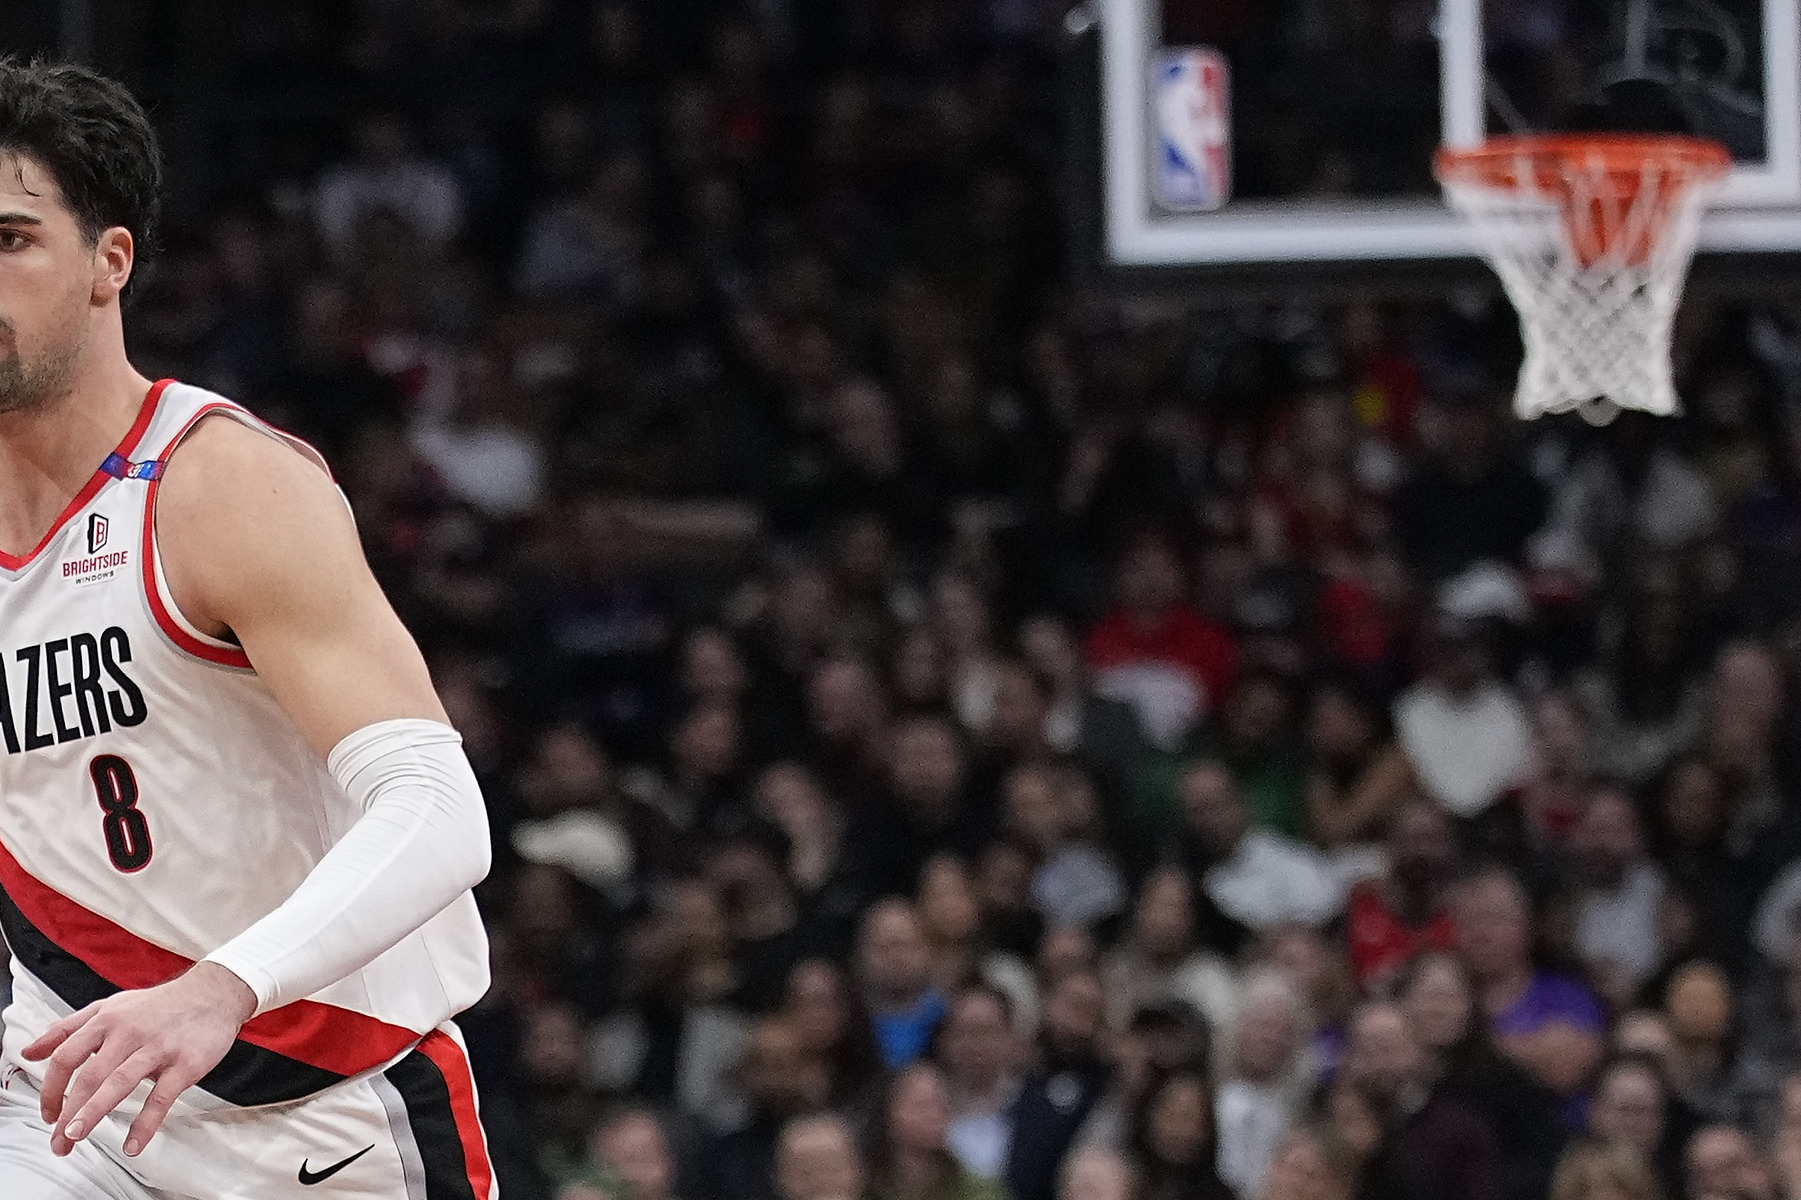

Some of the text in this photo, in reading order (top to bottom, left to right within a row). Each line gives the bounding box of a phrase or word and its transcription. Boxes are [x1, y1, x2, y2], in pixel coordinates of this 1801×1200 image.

[96, 521, 105, 545] B
[62, 551, 128, 577] BRIGHTSIDE
[75, 570, 114, 584] WINDOWS
[89, 753, 153, 873] 8
